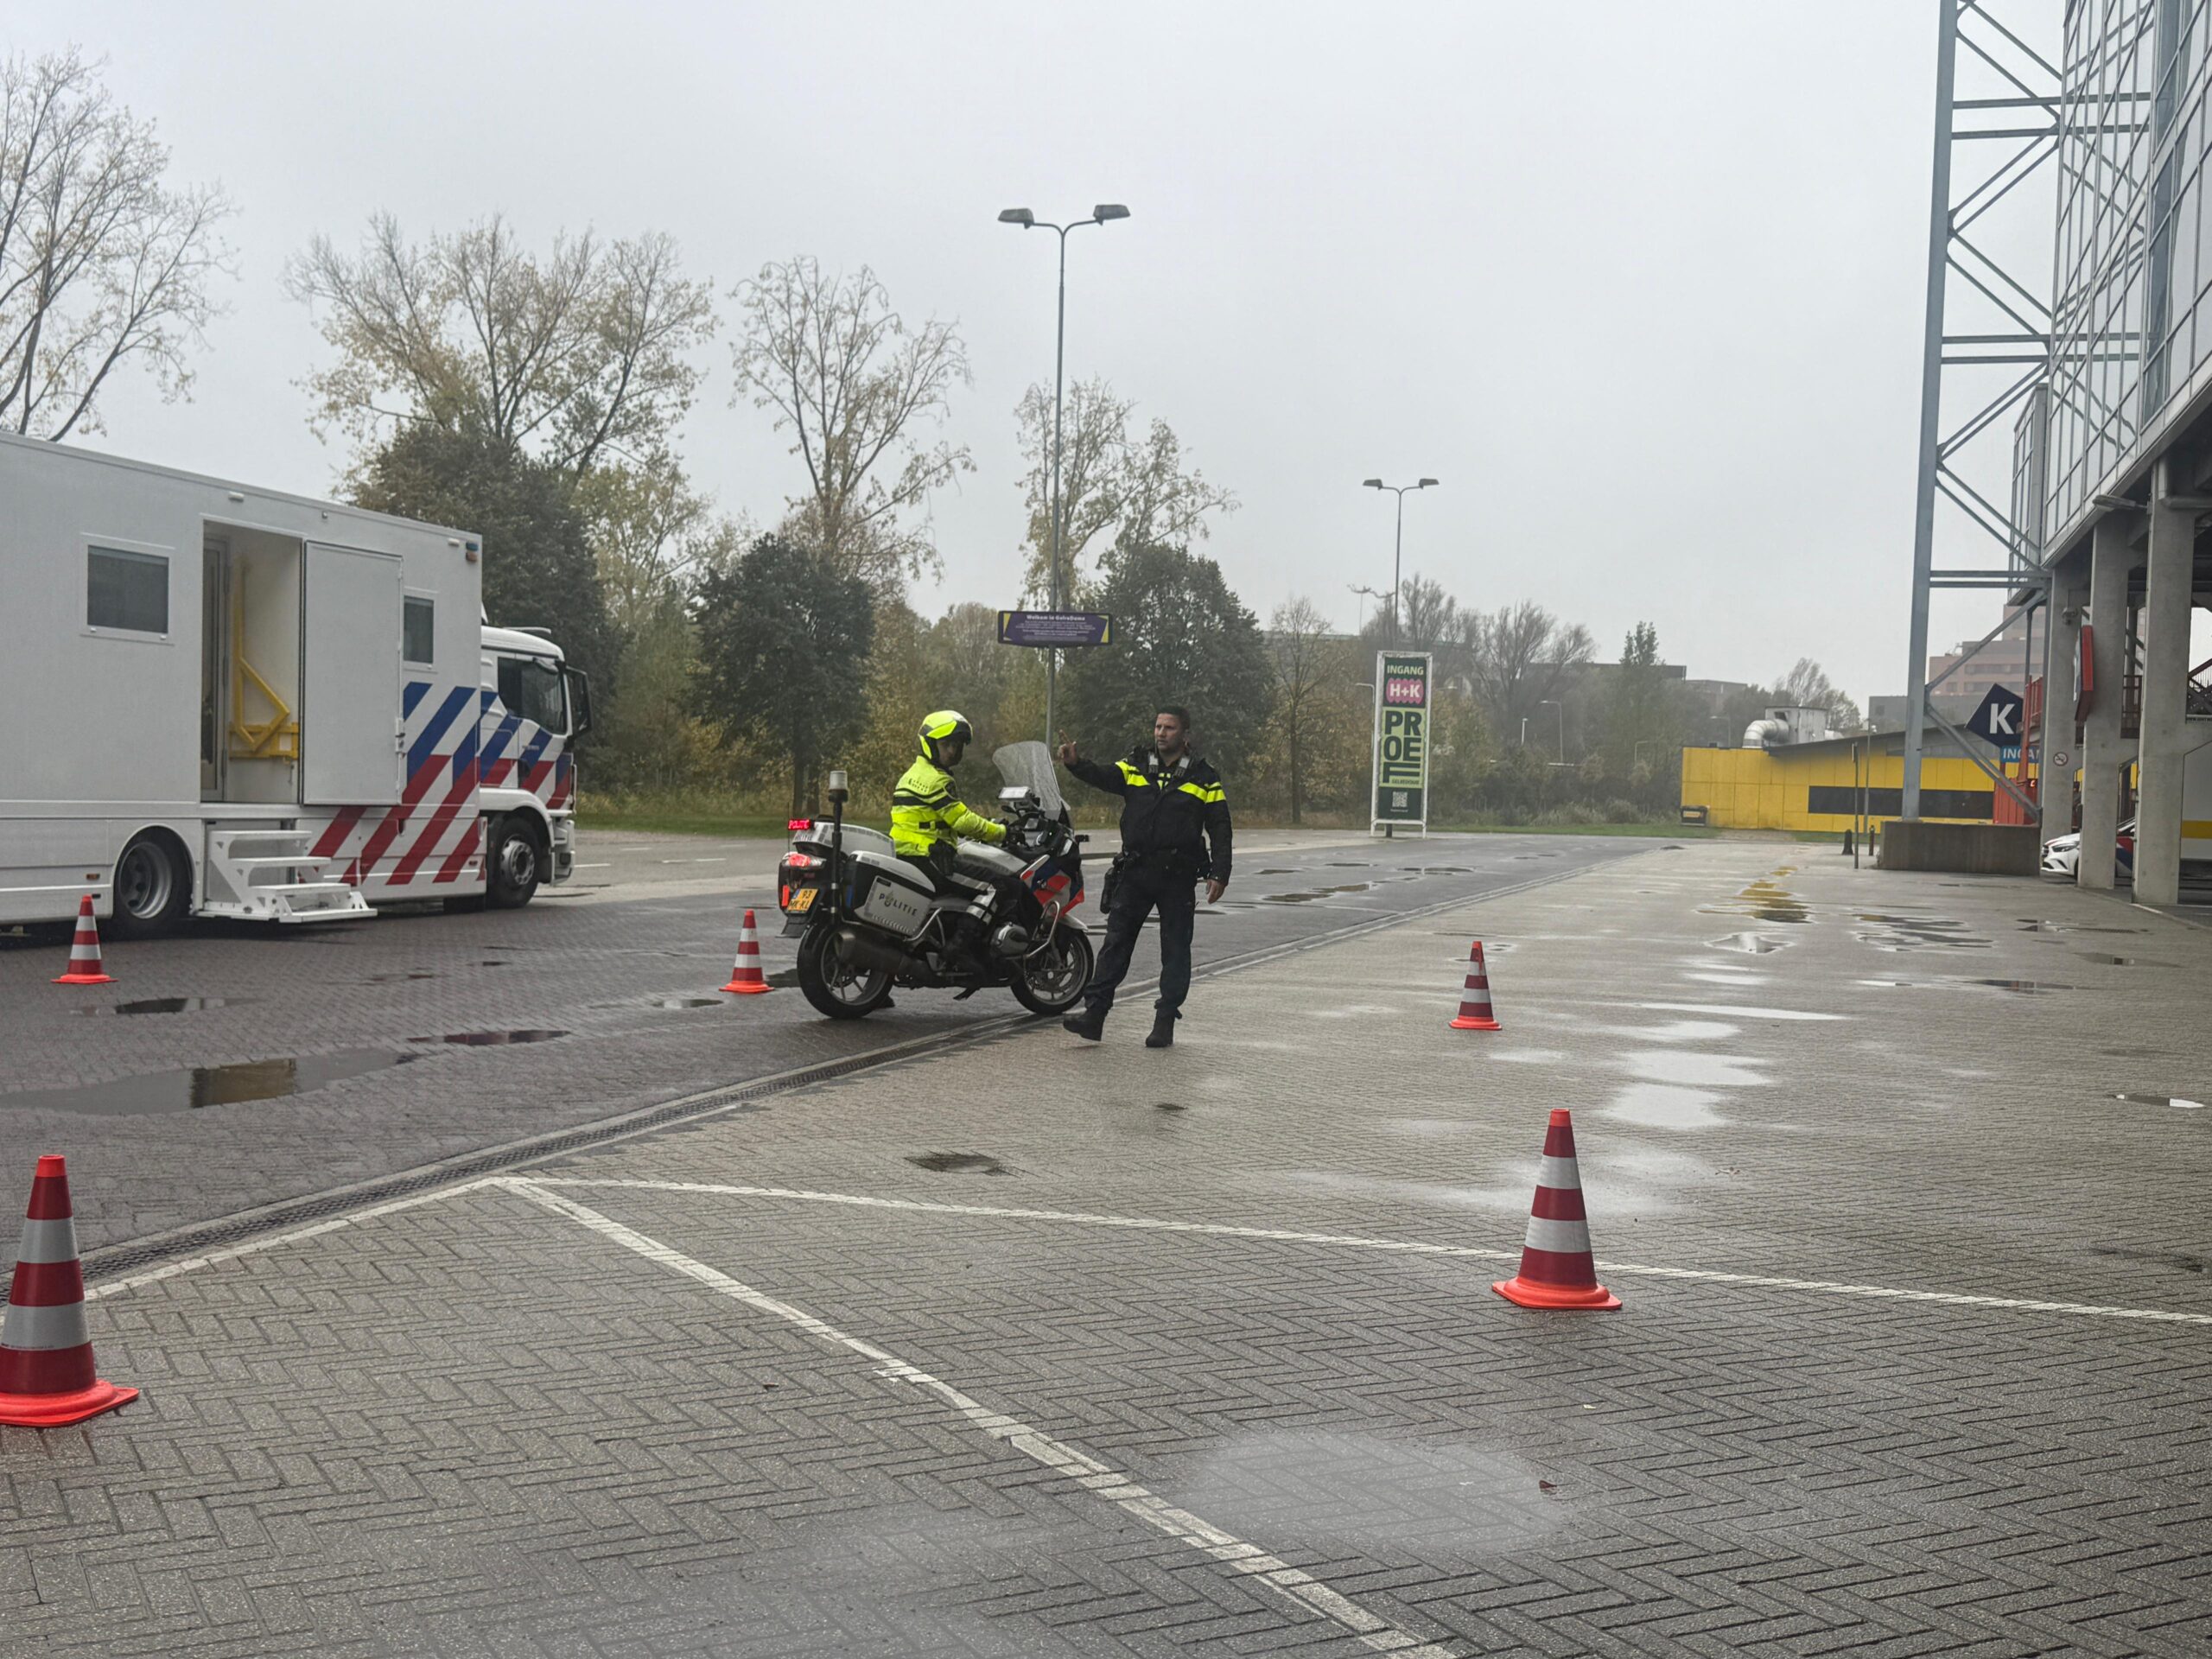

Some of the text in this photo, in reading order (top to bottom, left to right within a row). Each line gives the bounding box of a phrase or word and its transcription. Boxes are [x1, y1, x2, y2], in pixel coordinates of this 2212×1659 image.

[1387, 664, 1424, 675] INGANG
[1389, 683, 1421, 697] H+K
[1989, 702, 2016, 734] K
[878, 892, 918, 916] POLITIE
